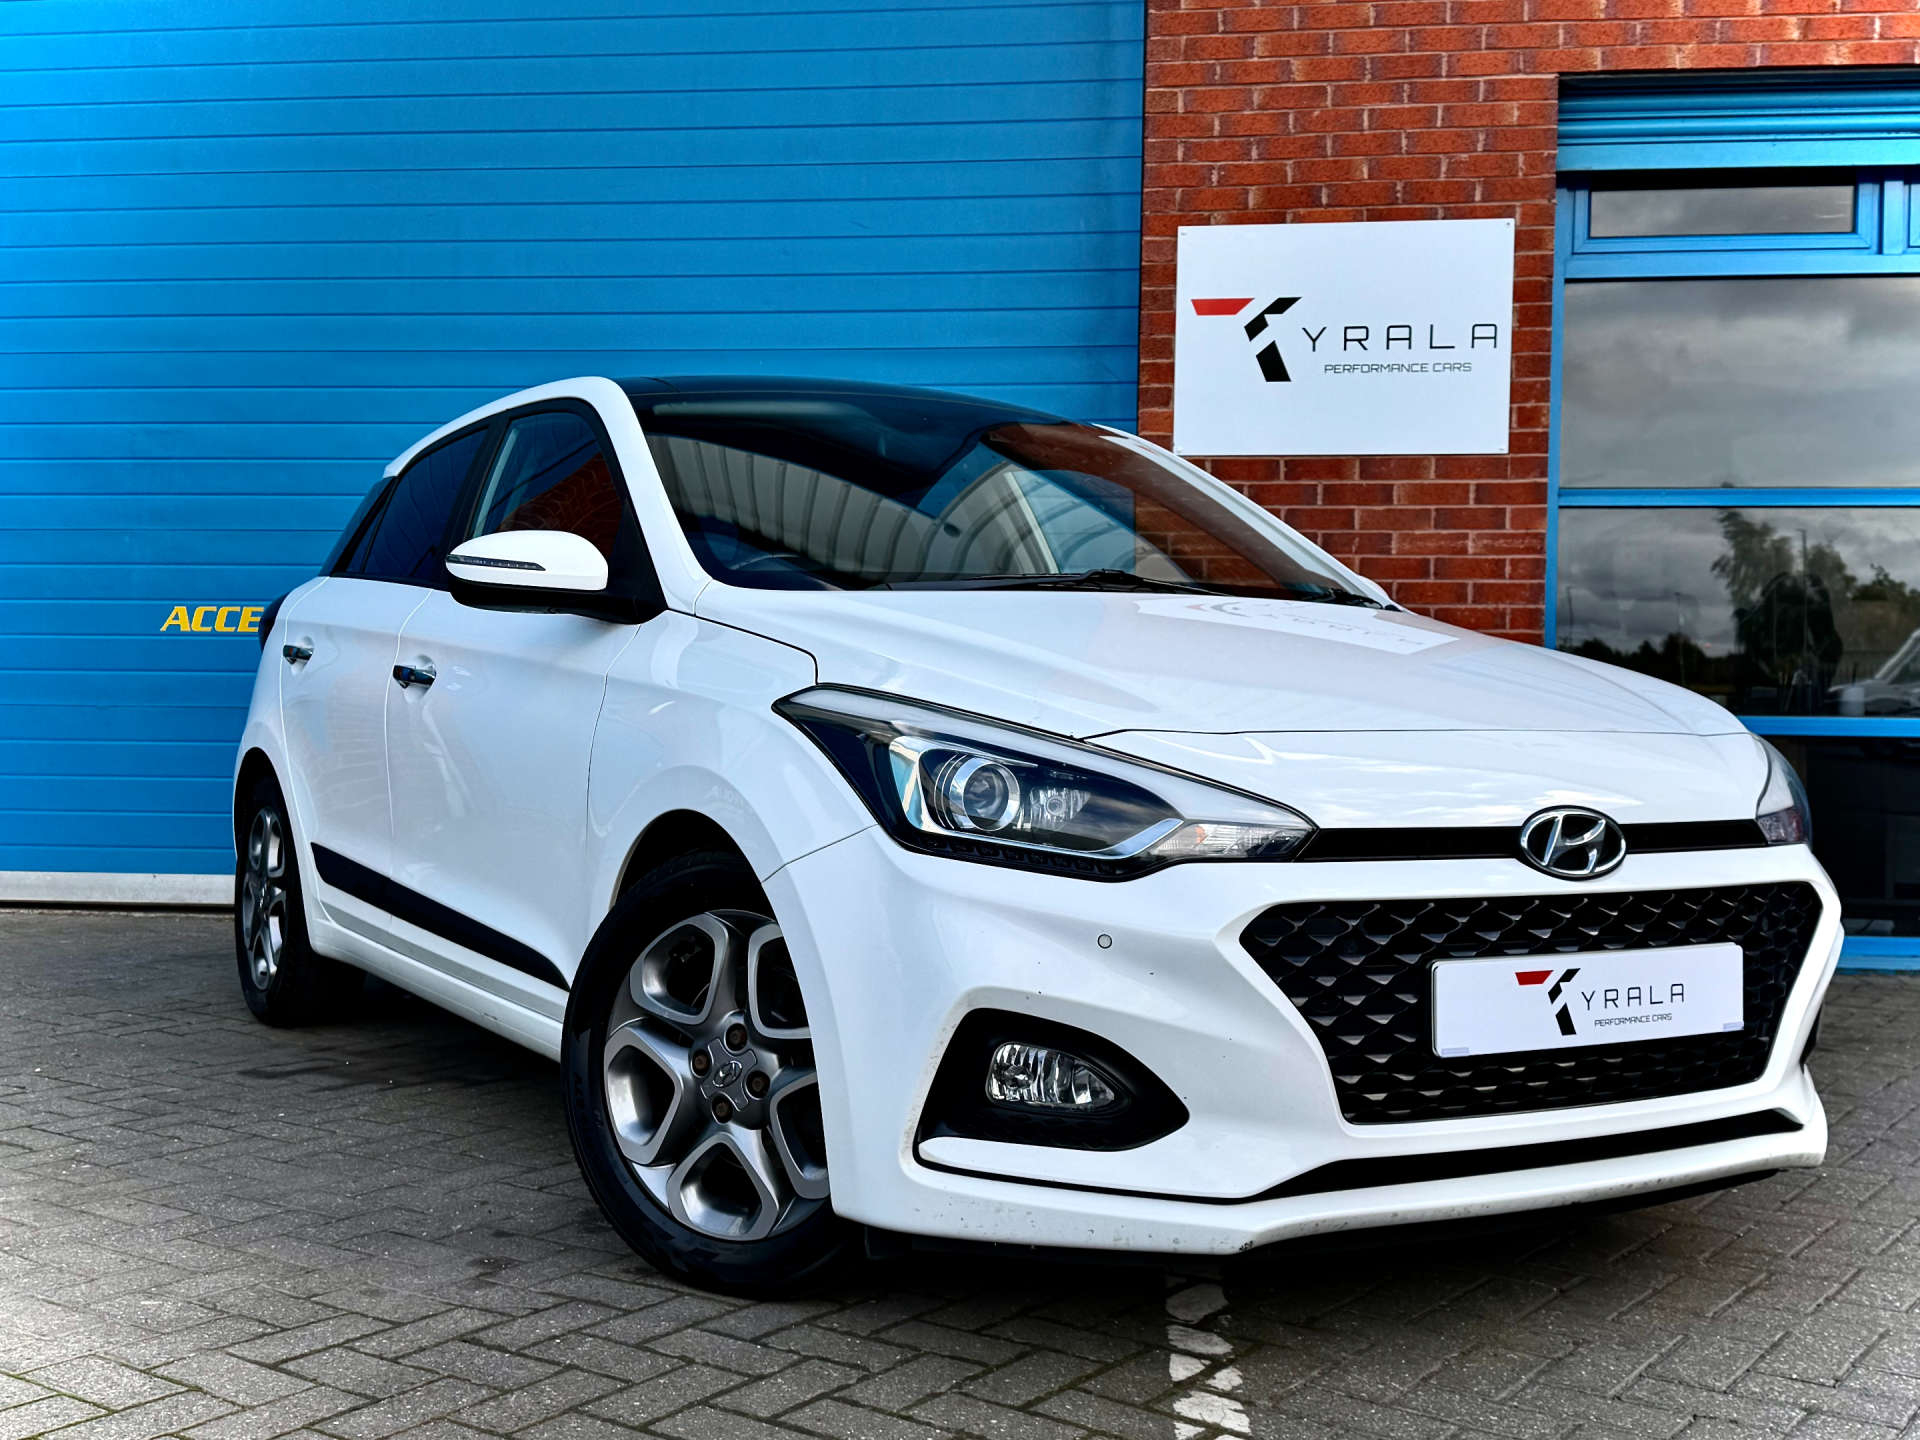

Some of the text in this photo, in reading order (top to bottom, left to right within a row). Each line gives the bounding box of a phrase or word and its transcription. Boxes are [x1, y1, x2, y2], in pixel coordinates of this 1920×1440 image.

[1324, 362, 1472, 374] PERFORMANCE CARS
[1594, 1012, 1672, 1027] PERFORMANCE CARS
